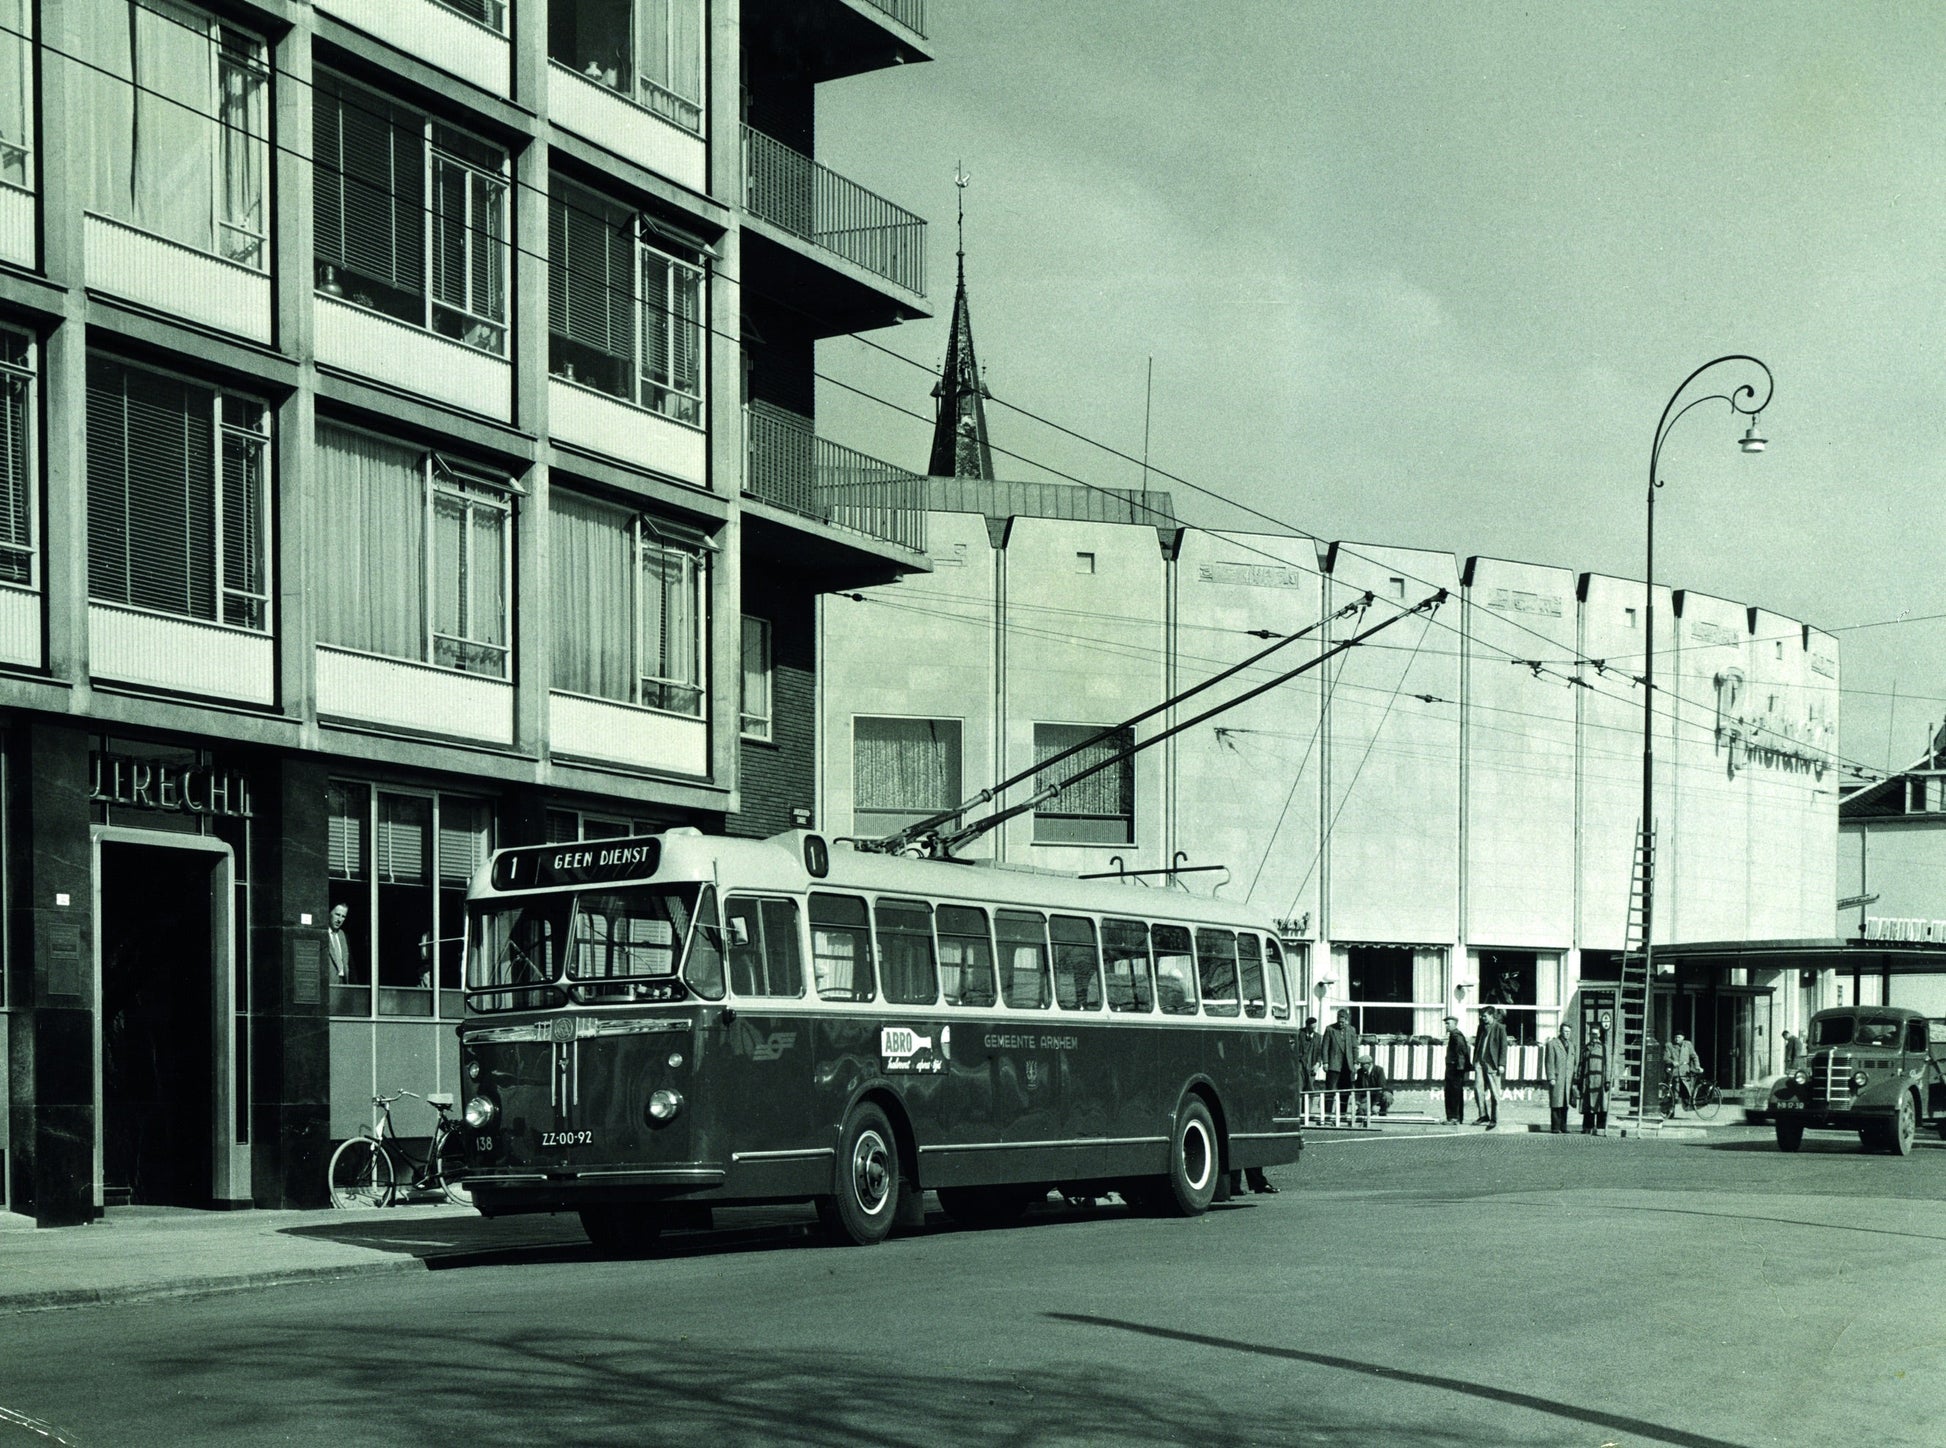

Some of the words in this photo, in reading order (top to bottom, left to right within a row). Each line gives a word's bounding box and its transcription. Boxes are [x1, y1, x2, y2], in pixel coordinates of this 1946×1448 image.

[554, 852, 593, 869] GEEN
[600, 846, 649, 866] DIENST
[510, 856, 518, 879] 1
[885, 1031, 912, 1053] ABRO
[984, 1034, 1036, 1049] GEMEENTE
[1040, 1035, 1078, 1050] ARNHEM
[476, 1136, 493, 1151] 138
[542, 1130, 593, 1146] ZZ-00-92
